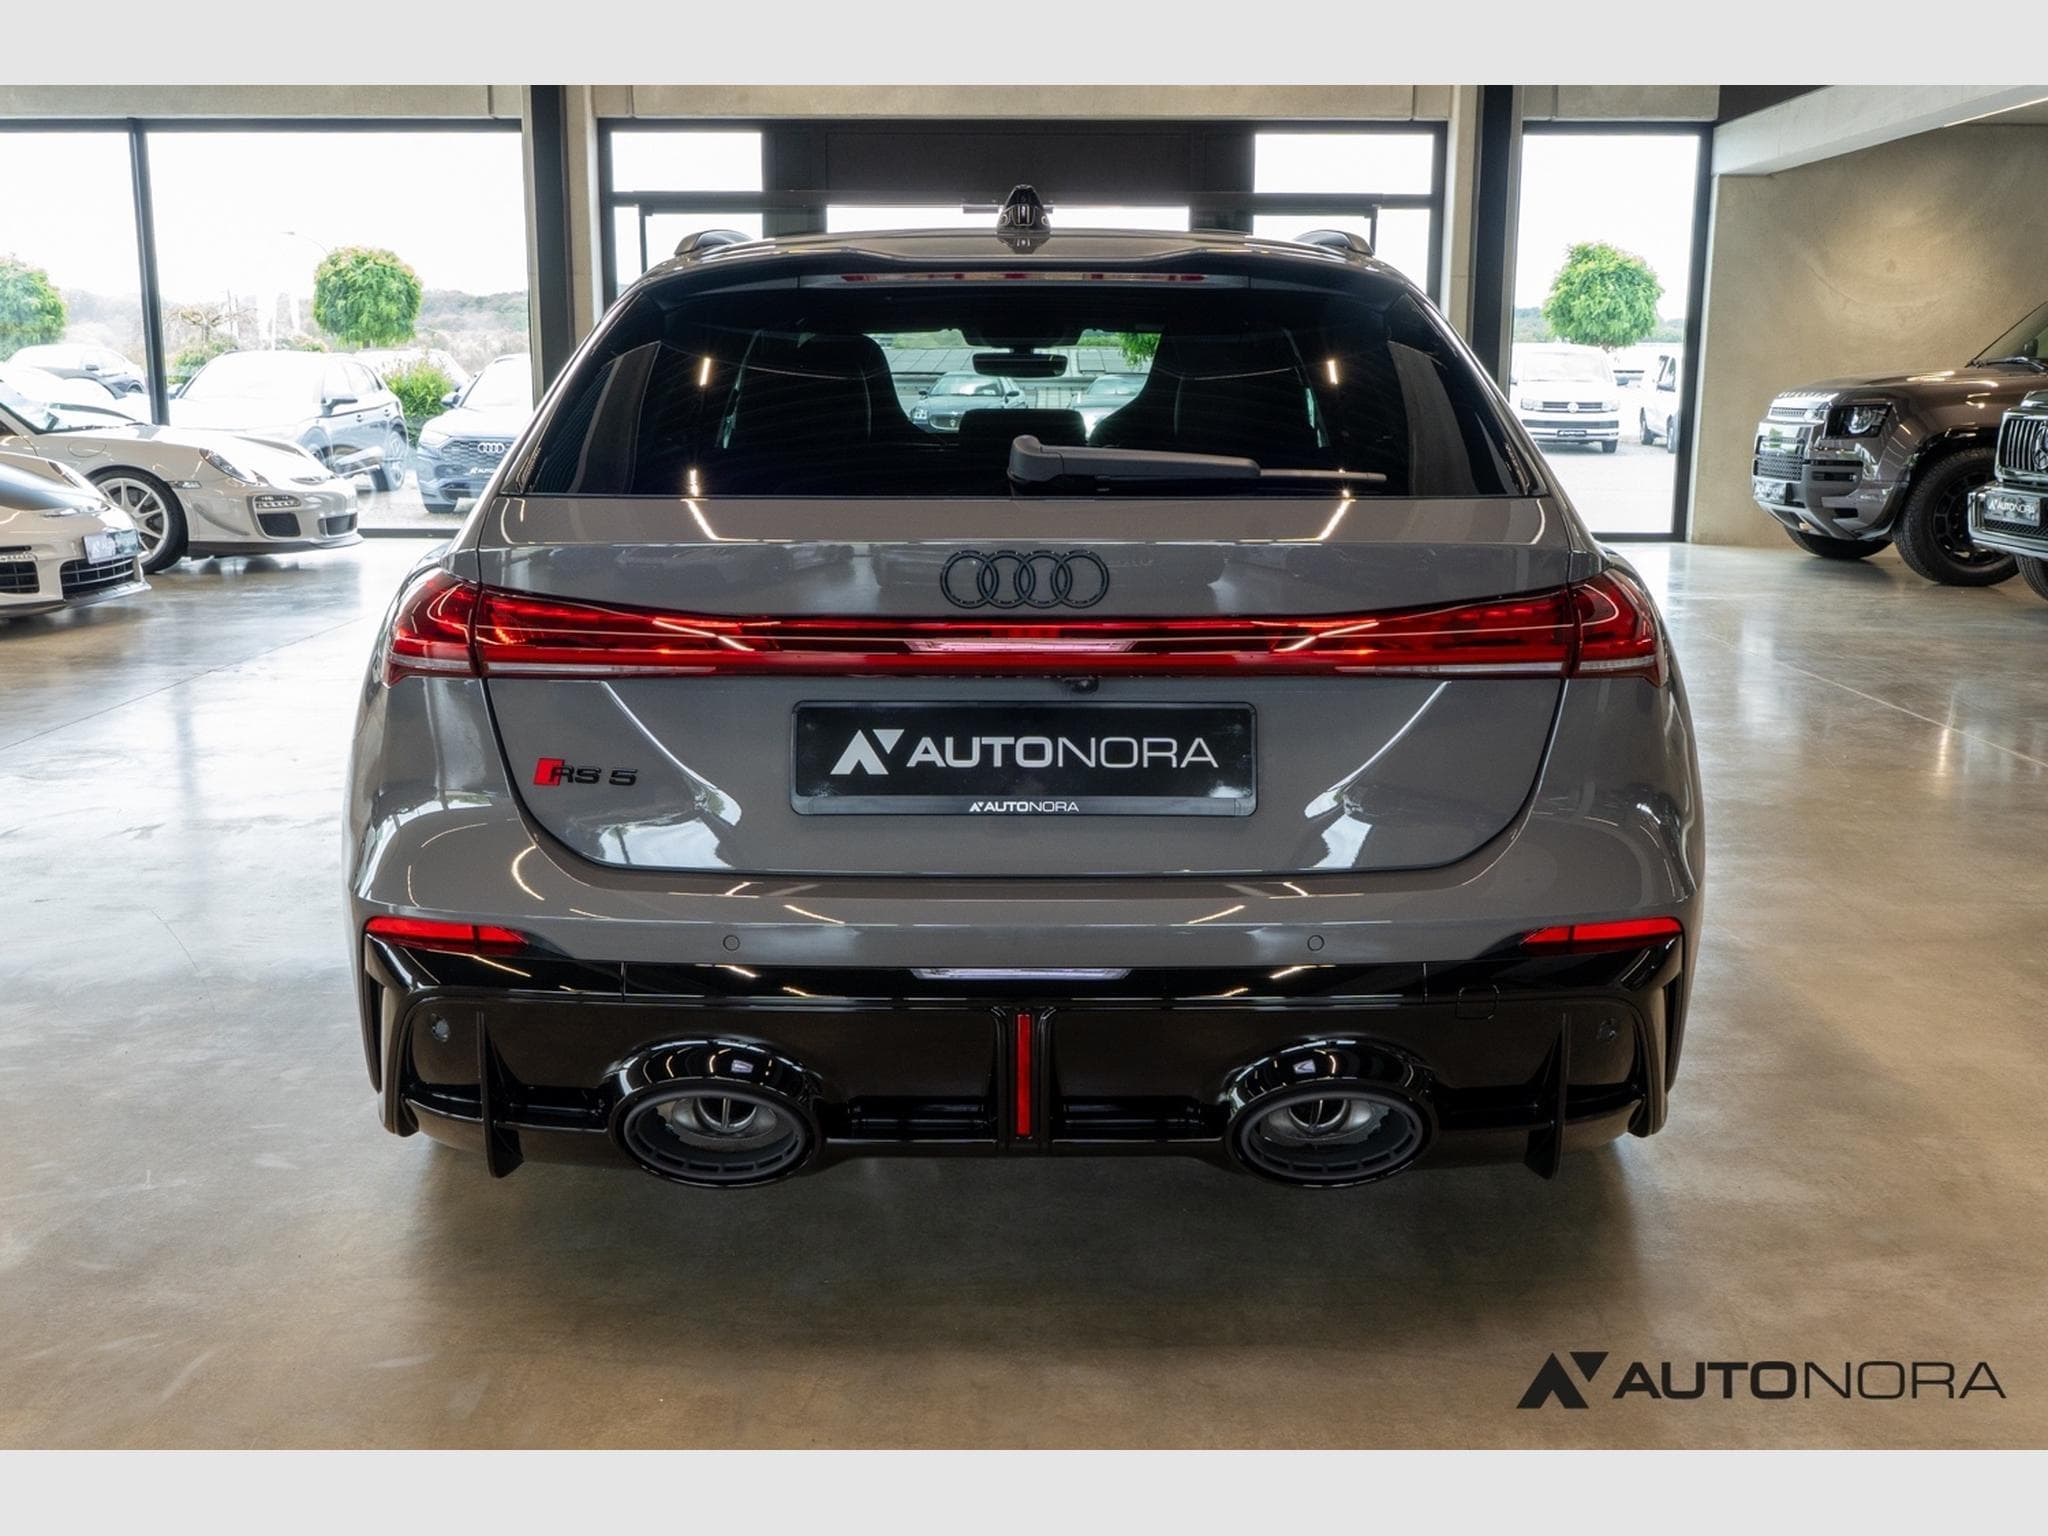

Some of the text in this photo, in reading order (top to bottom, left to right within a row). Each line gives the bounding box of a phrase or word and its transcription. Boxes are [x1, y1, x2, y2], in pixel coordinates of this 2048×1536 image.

[907, 737, 1219, 768] AUTONORA
[549, 766, 638, 785] RS 5
[984, 801, 1080, 812] AUTONORA
